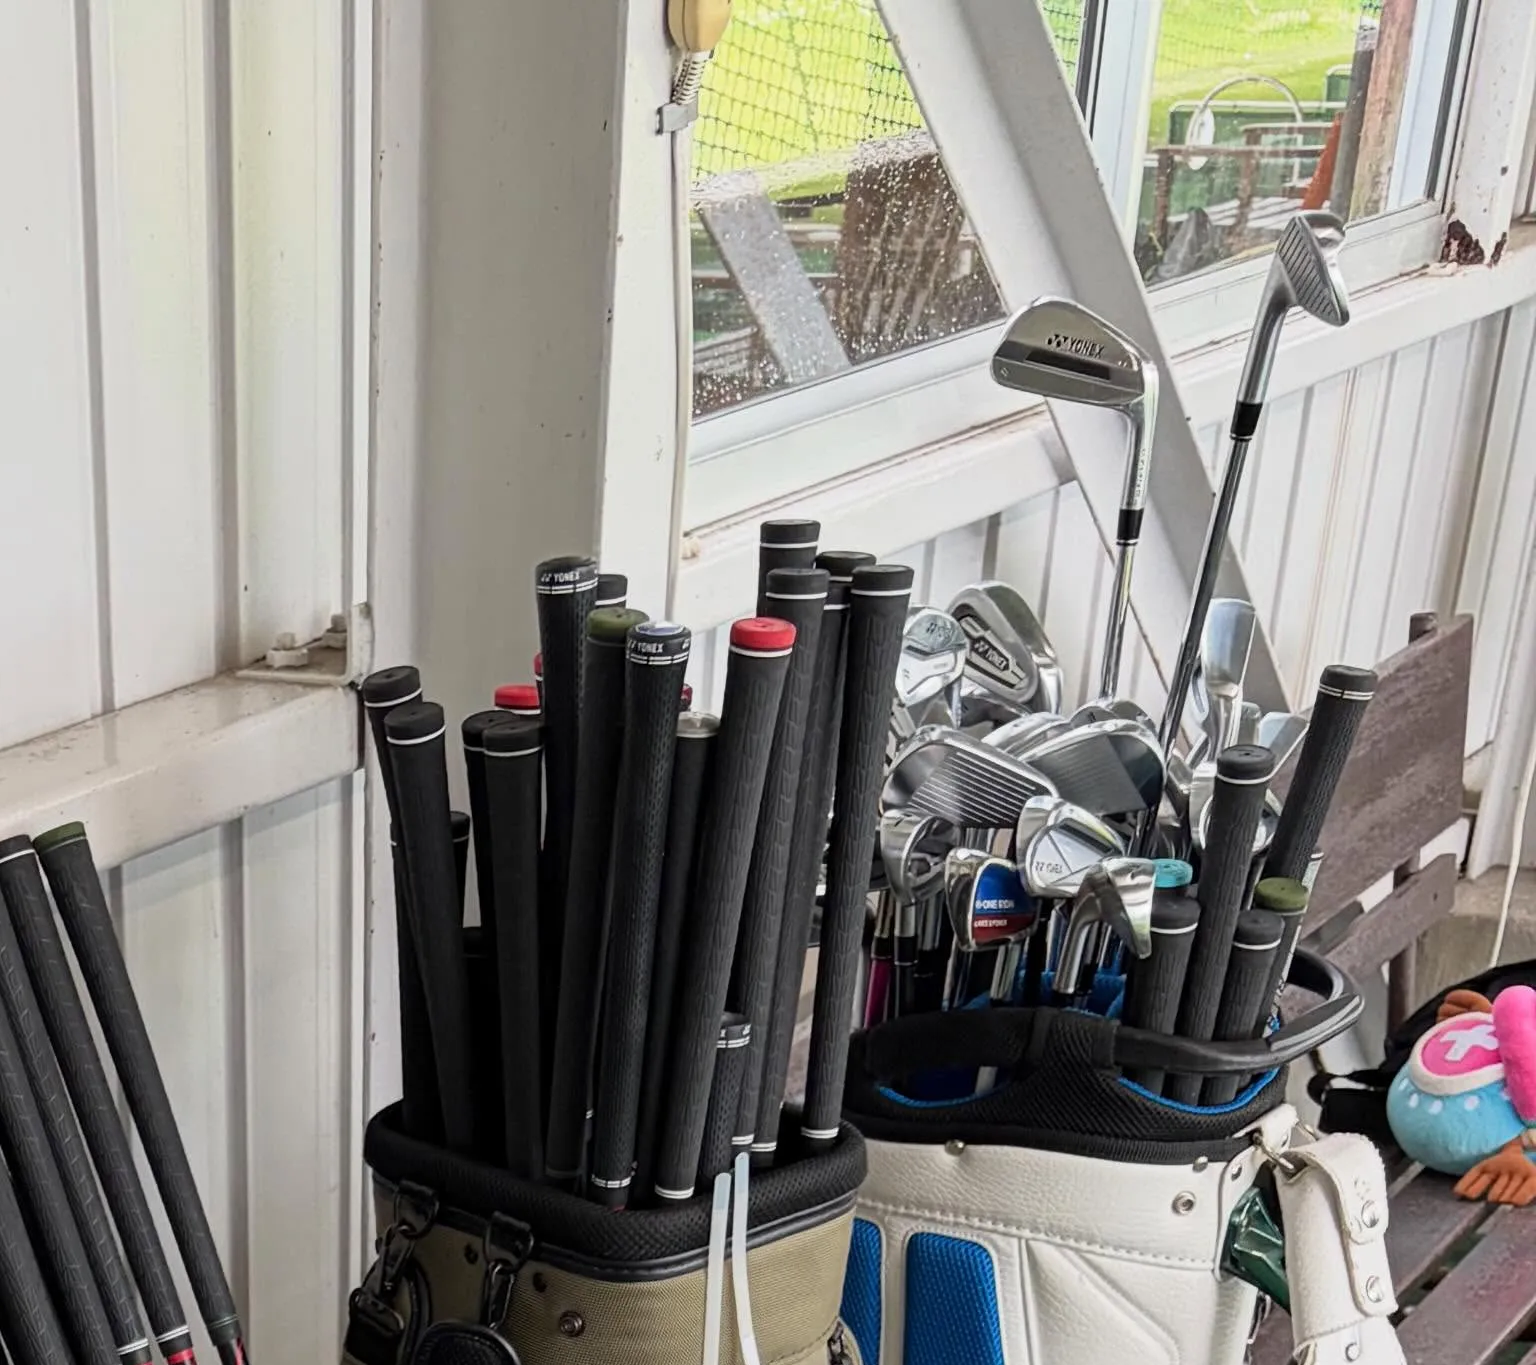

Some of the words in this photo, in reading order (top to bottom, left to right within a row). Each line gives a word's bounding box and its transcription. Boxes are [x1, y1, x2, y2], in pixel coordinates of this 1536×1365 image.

[1069, 336, 1105, 359] YONEX
[554, 571, 580, 583] YONEX
[637, 642, 664, 653] YONEX
